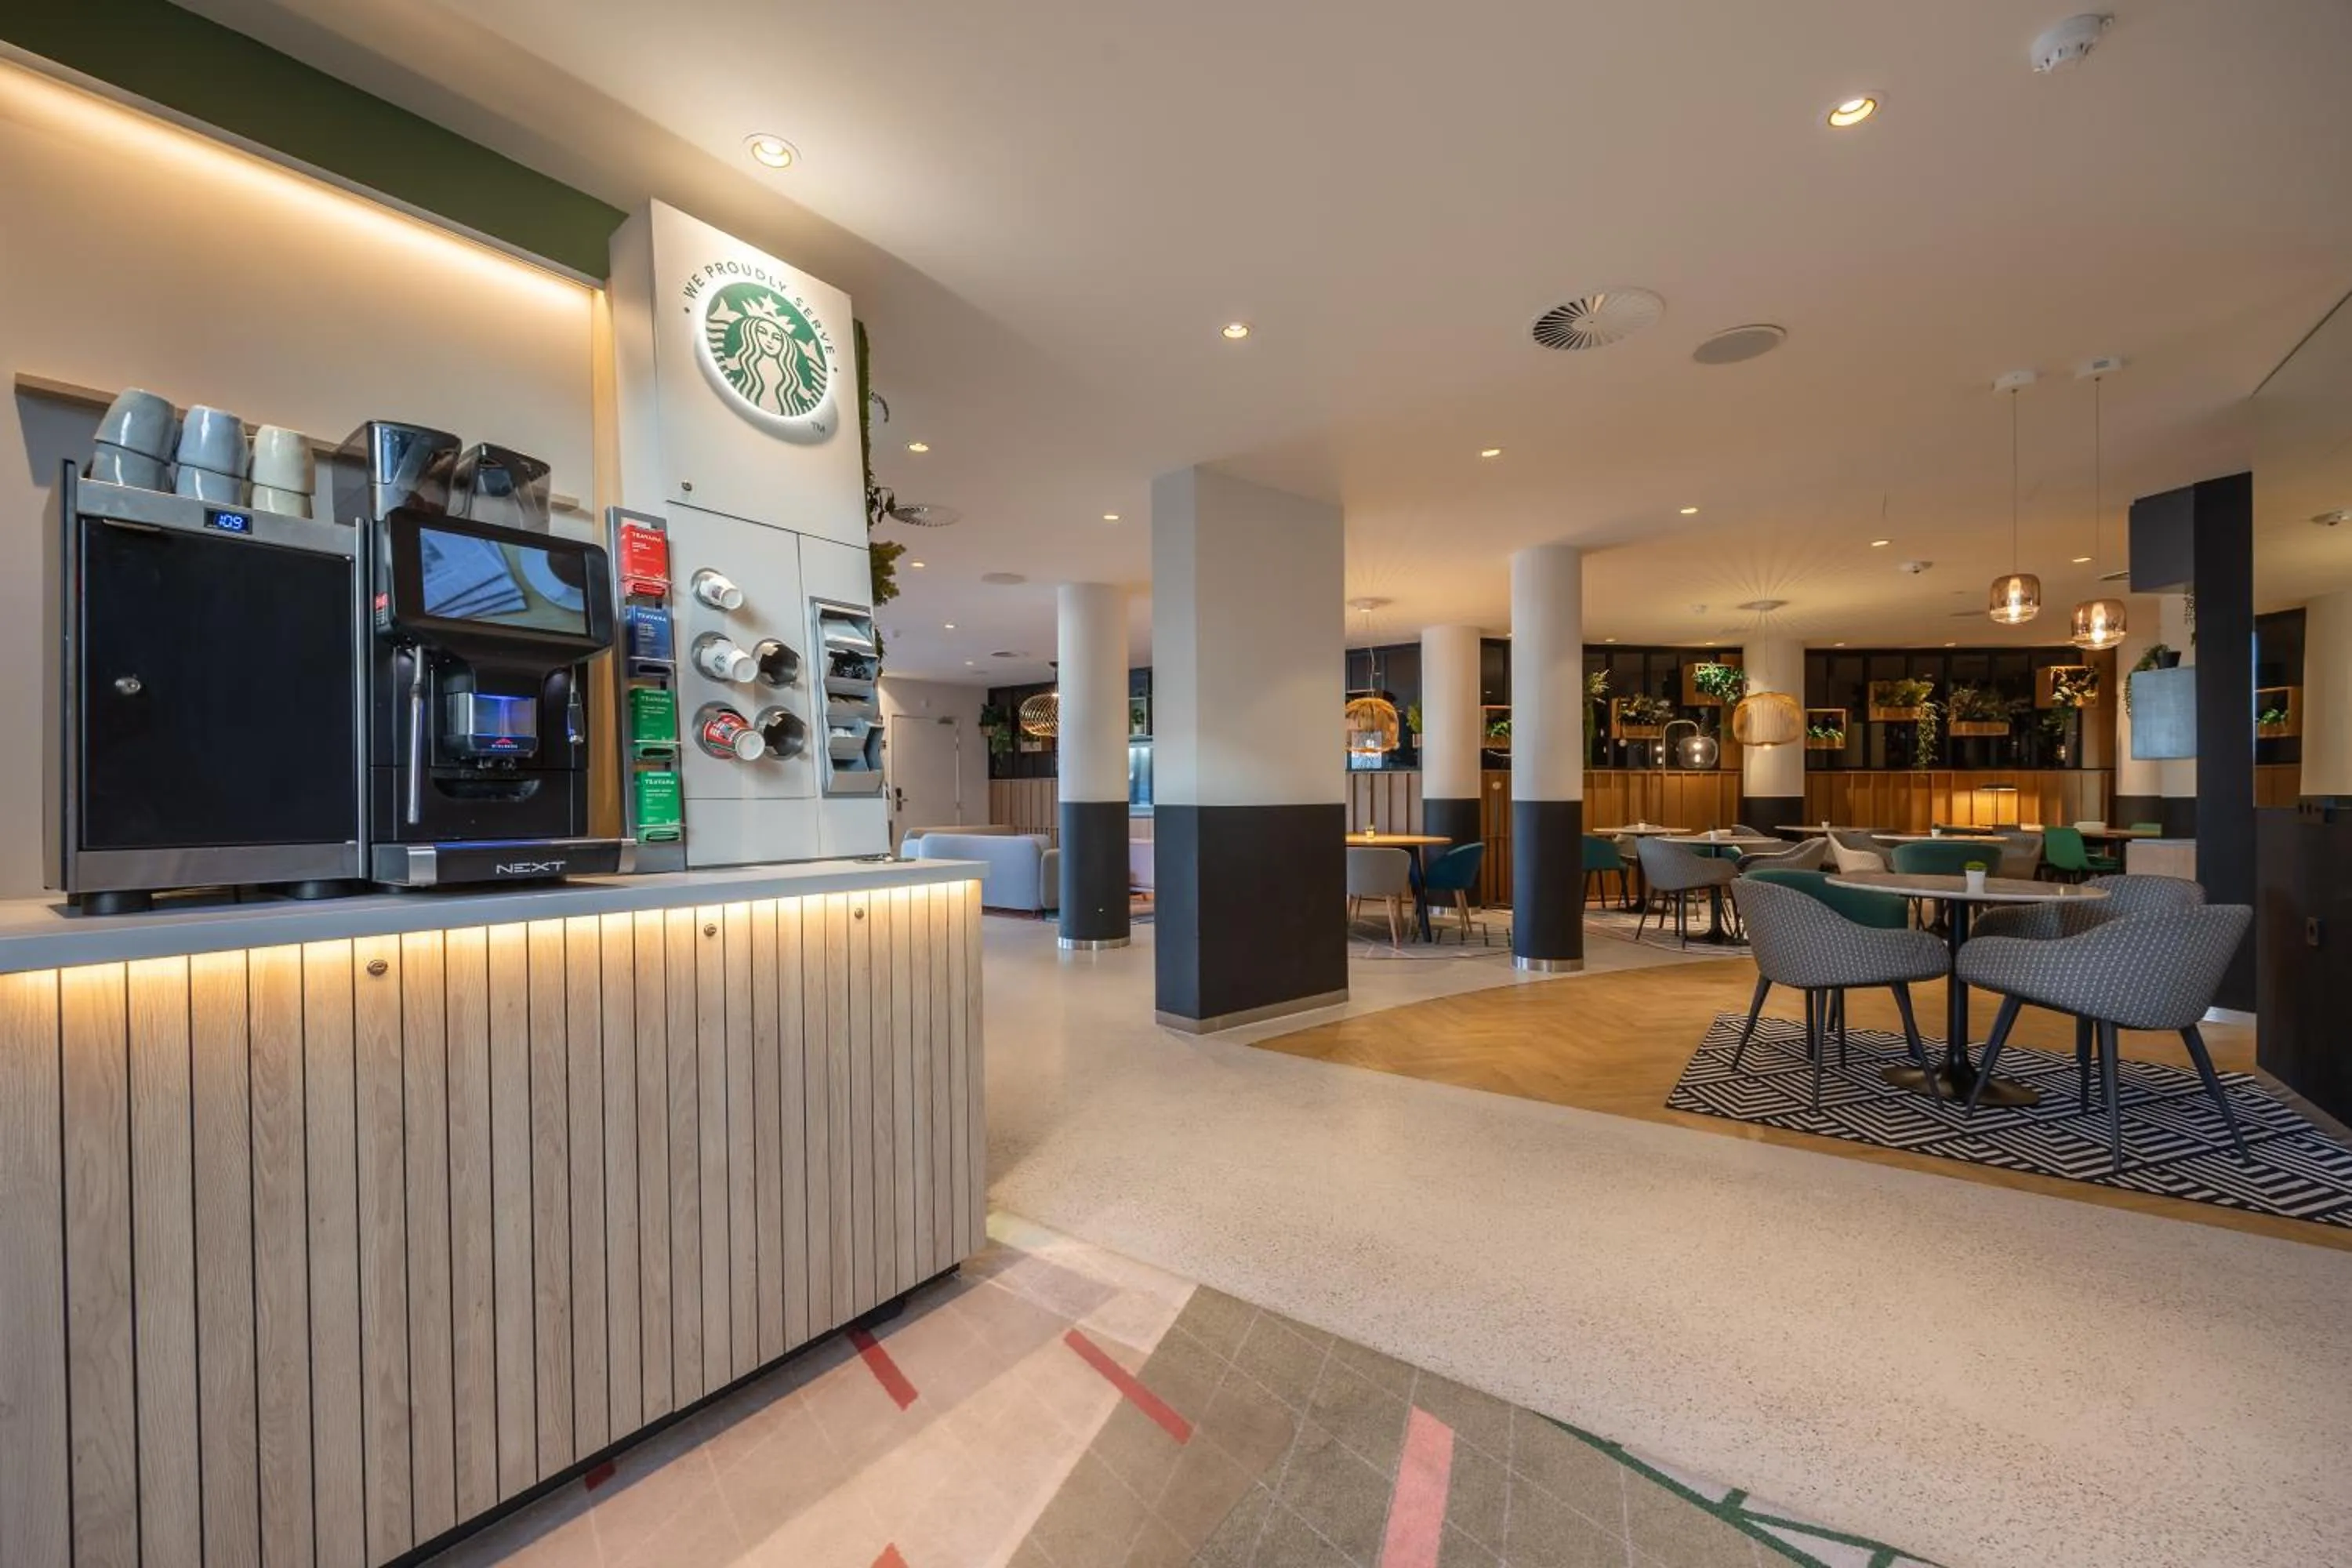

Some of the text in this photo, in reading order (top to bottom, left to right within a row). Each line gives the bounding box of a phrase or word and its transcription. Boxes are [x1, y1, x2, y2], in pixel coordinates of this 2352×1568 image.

[683, 261, 835, 354] WE PROUDLY SERVE
[496, 861, 566, 874] NEXT
